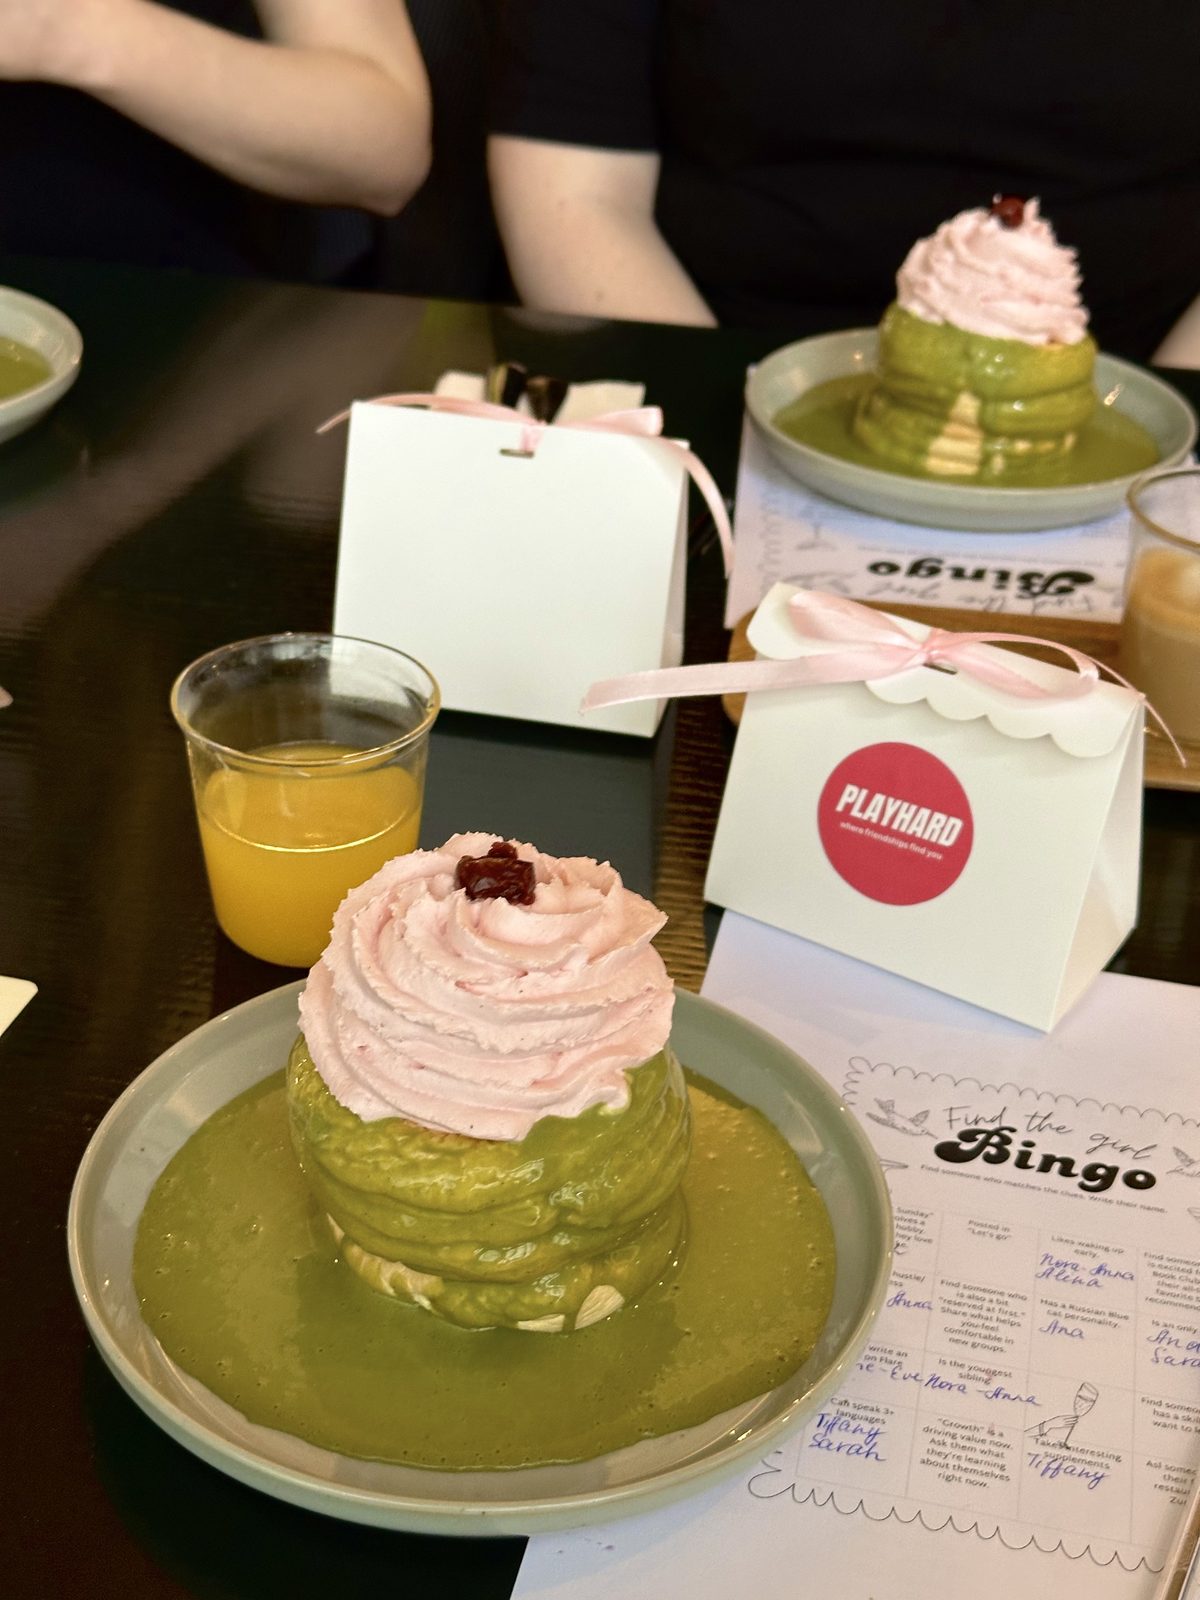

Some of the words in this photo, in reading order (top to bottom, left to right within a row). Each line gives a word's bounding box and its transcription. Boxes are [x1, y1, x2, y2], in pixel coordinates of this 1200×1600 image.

[867, 557, 1094, 597] Bingo
[835, 783, 963, 847] PLAYHARD
[840, 821, 863, 834] where
[864, 828, 908, 849] friendships
[909, 842, 926, 855] find
[927, 850, 943, 861] you
[943, 1106, 1007, 1130] Find
[1025, 1111, 1073, 1134] the
[1086, 1133, 1158, 1159] girl
[934, 1126, 1156, 1192] Bingo
[921, 1163, 939, 1173] Find
[941, 1167, 981, 1180] someone
[983, 1176, 1002, 1184] who
[1003, 1180, 1041, 1192] matches
[1044, 1186, 1059, 1194] the
[1060, 1190, 1086, 1200] clues.
[1088, 1194, 1114, 1205] Write
[1116, 1199, 1137, 1209] their
[1140, 1204, 1168, 1214] name.
[968, 1220, 999, 1231] Posted
[896, 1232, 912, 1242] hey
[914, 1235, 933, 1244] love
[1051, 1235, 1075, 1245] Likes
[1077, 1240, 1110, 1253] waking
[1144, 1252, 1164, 1260] Find
[1152, 1271, 1176, 1281] Book
[1158, 1263, 1193, 1275] excited
[940, 1279, 960, 1289] Find
[962, 1283, 1005, 1297] someone
[1007, 1292, 1028, 1302] who
[1157, 1280, 1180, 1289] their
[956, 1291, 965, 1299] is
[967, 1293, 986, 1303] also
[996, 1299, 1009, 1307] bit
[940, 1306, 968, 1318] Share
[970, 1311, 994, 1322] what
[996, 1315, 1022, 1328] helps
[985, 1305, 996, 1313] at
[1040, 1299, 1058, 1308] Has
[1069, 1303, 1106, 1316] Russian
[1108, 1311, 1129, 1321] Blue
[1047, 1309, 1062, 1318] cat
[961, 1320, 978, 1329] you
[1162, 1321, 1174, 1329] an
[1176, 1324, 1198, 1335] only
[943, 1325, 1003, 1343] comfortable
[1004, 1337, 1014, 1345] in
[868, 1345, 894, 1355] write
[949, 1336, 968, 1346] new
[971, 1341, 1007, 1354] groups.
[949, 1361, 965, 1369] the
[967, 1364, 1013, 1379] youngest
[958, 1371, 992, 1386] sibling
[830, 1397, 850, 1407] Can
[852, 1402, 880, 1414] speak
[1141, 1396, 1163, 1407] Find
[836, 1407, 886, 1425] languages
[1152, 1407, 1171, 1418] has
[1152, 1420, 1178, 1431] want
[1180, 1424, 1193, 1433] to
[922, 1425, 958, 1440] driving
[959, 1433, 987, 1445] value
[989, 1440, 1014, 1450] now.
[808, 1433, 887, 1462] Sarah
[929, 1437, 947, 1447] Ask
[950, 1441, 977, 1454] them
[979, 1447, 1005, 1459] what
[920, 1456, 950, 1470] about
[952, 1462, 1011, 1482] themselves
[926, 1448, 962, 1462] they're
[964, 1454, 1007, 1472] learning
[1044, 1450, 1111, 1470] supplements
[938, 1472, 962, 1484] right
[965, 1478, 990, 1489] now.
